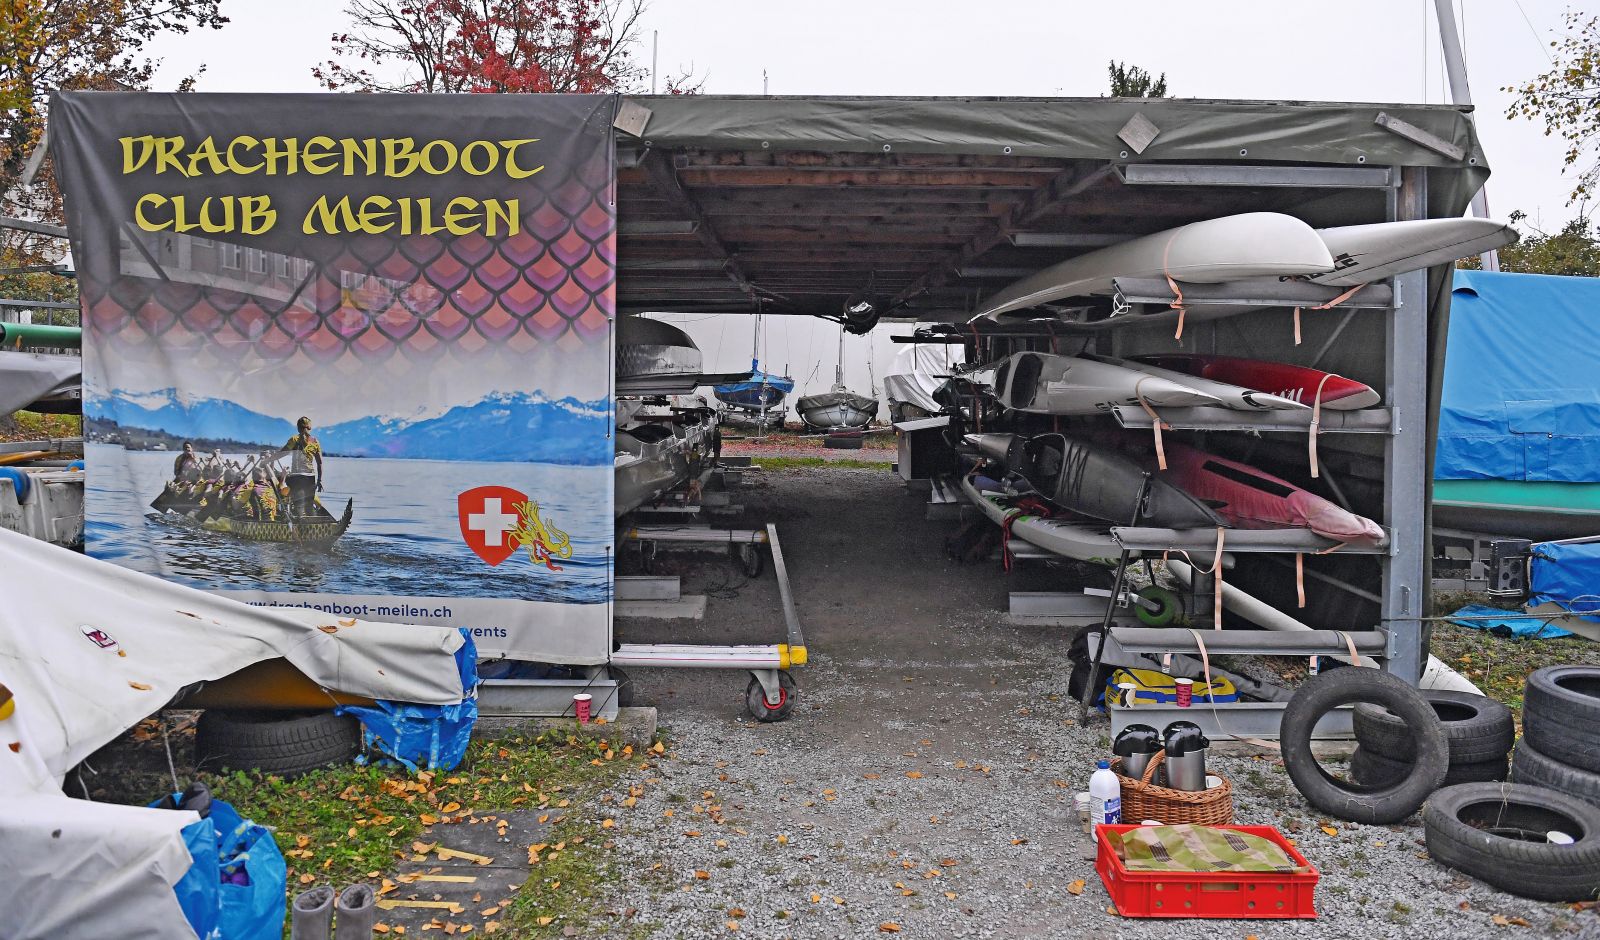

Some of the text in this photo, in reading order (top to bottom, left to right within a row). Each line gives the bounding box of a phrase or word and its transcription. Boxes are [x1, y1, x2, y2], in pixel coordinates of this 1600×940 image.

[120, 135, 545, 179] DRACHENBOOT
[135, 193, 520, 237] CLUB MEILEN
